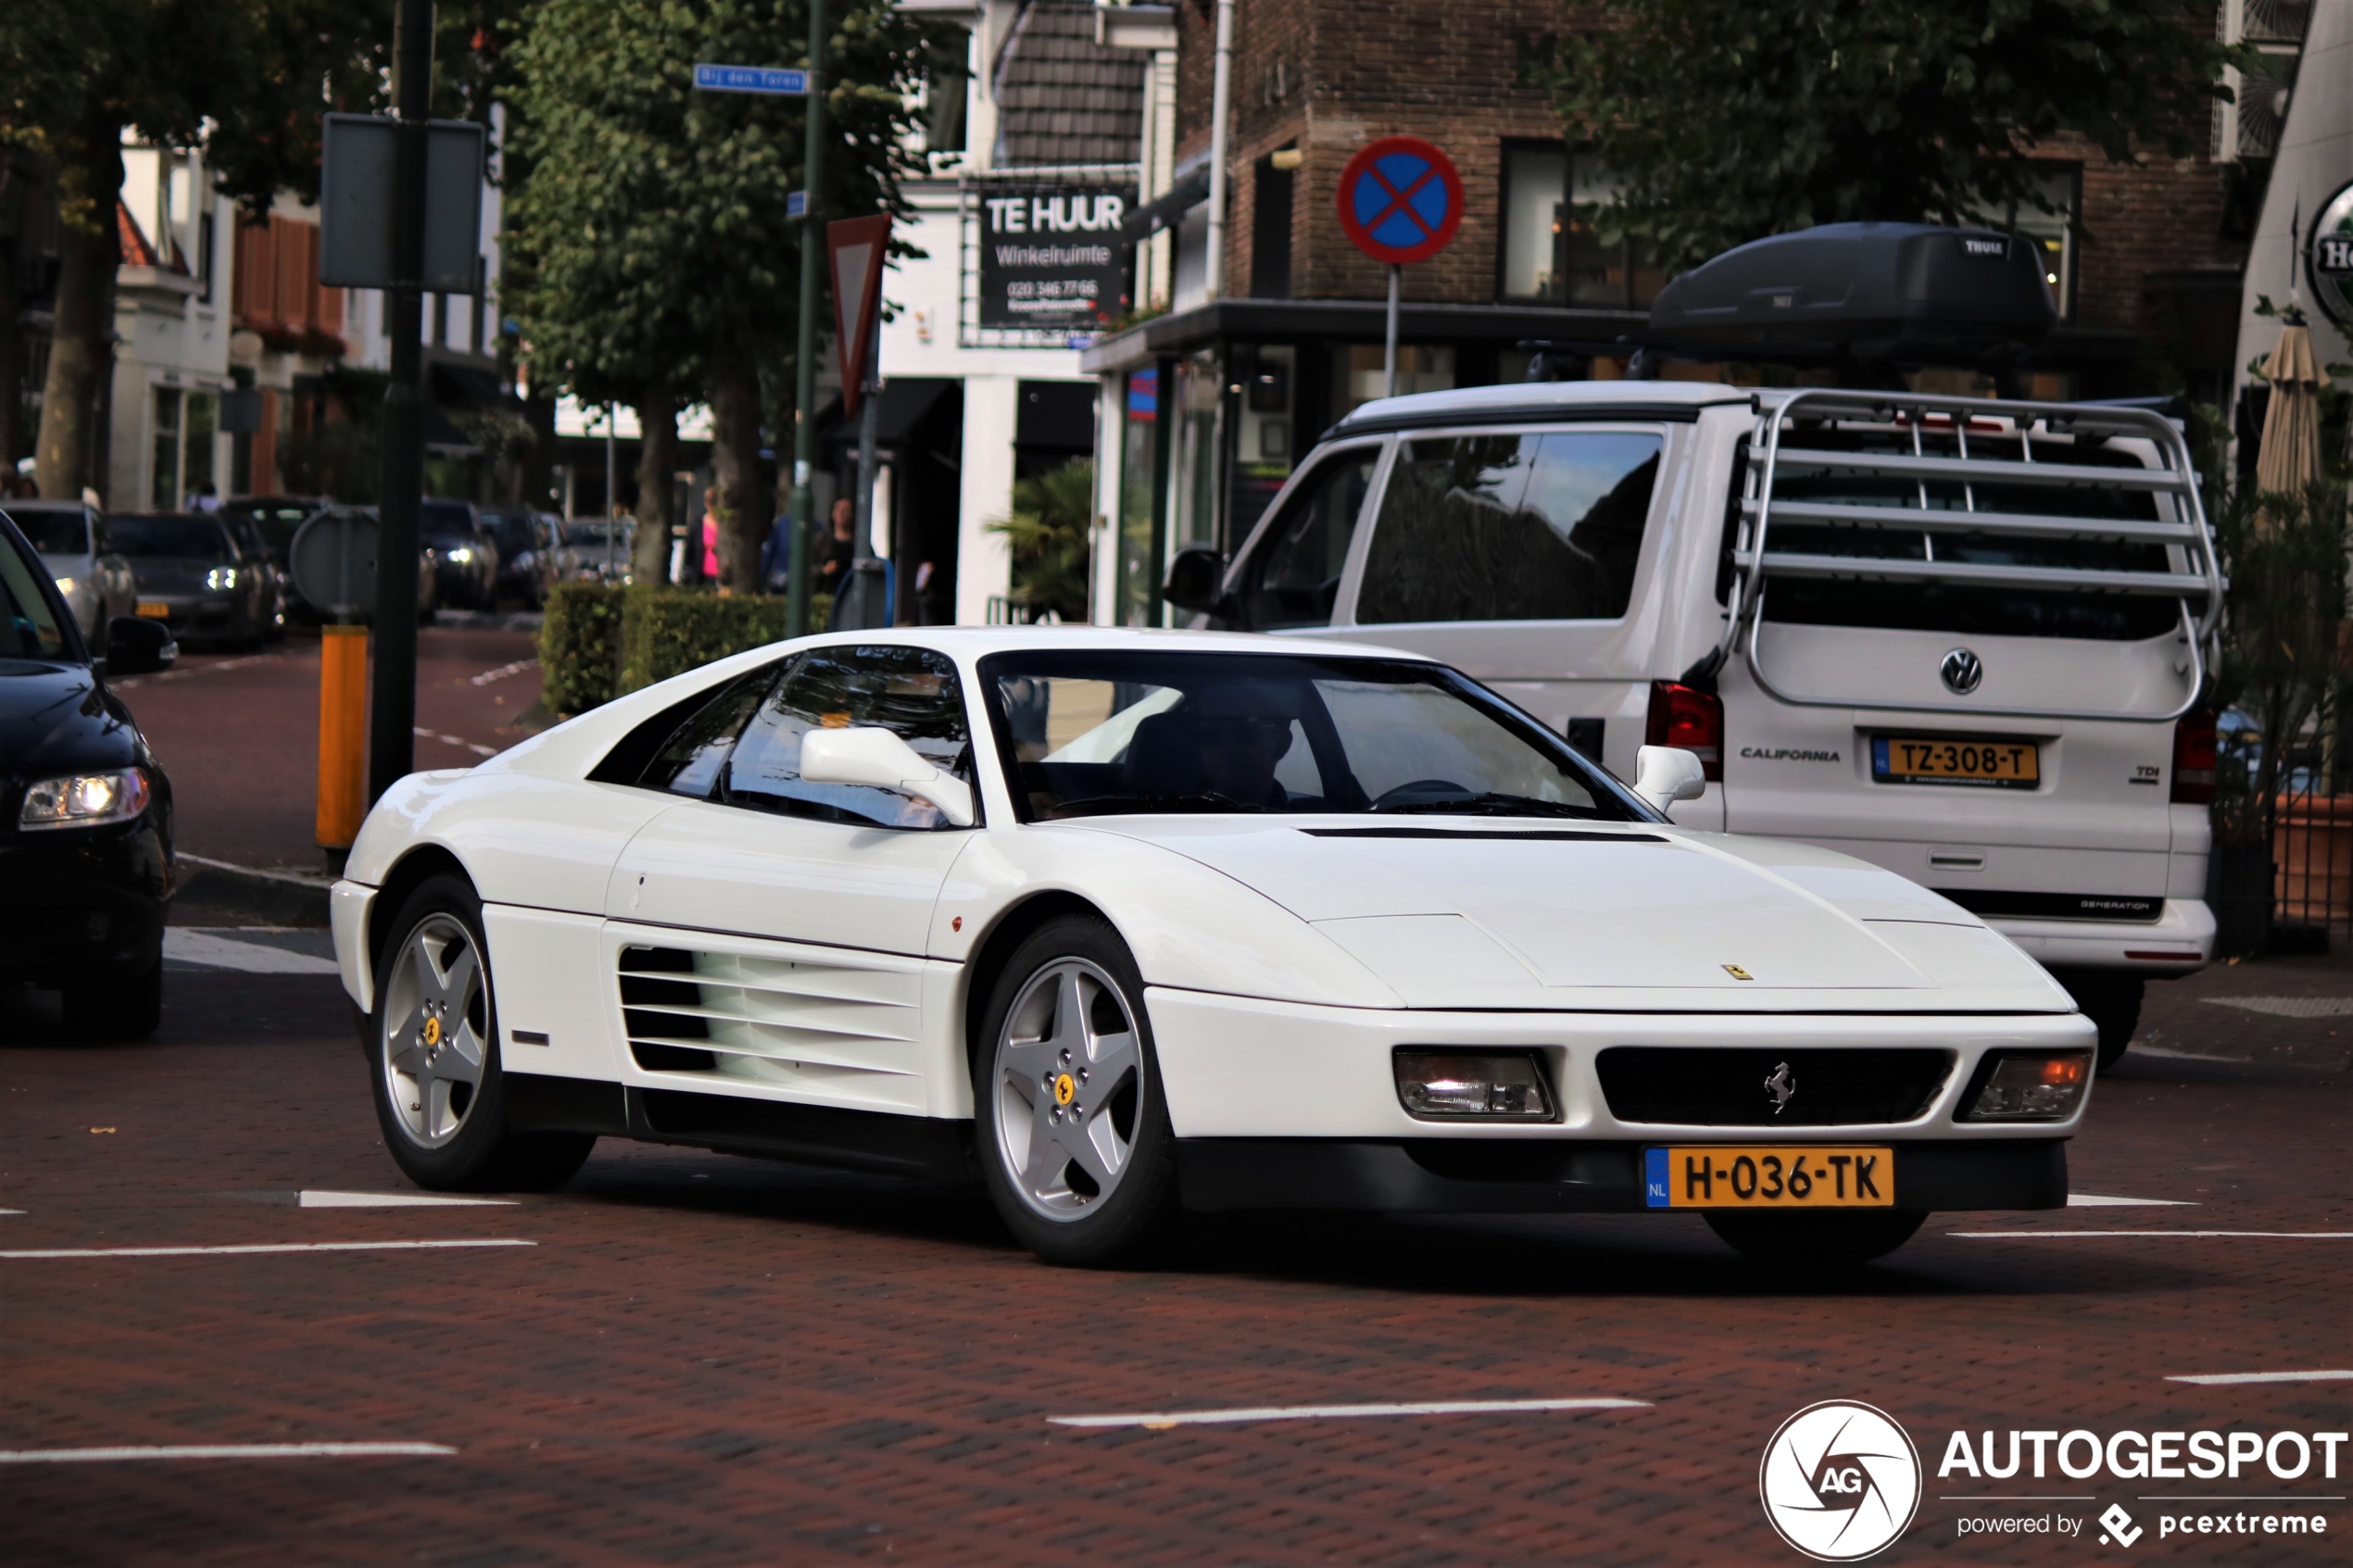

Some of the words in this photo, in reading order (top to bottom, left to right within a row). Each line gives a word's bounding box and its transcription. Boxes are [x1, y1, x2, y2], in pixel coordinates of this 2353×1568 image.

[986, 197, 1027, 232] TE
[1032, 194, 1124, 232] HUUR
[996, 244, 1112, 267] Winkelruimte
[1966, 240, 2002, 254] THULE
[2325, 241, 2353, 268] H
[1007, 281, 1036, 299] 020
[1740, 746, 1840, 763] CALIFORNIA
[1901, 744, 2024, 774] TZ-308-T
[2136, 766, 2159, 776] TDI
[2081, 900, 2149, 910] GENERATION
[1686, 1155, 1881, 1199] H-036-TK
[1649, 1183, 1667, 1197] NL
